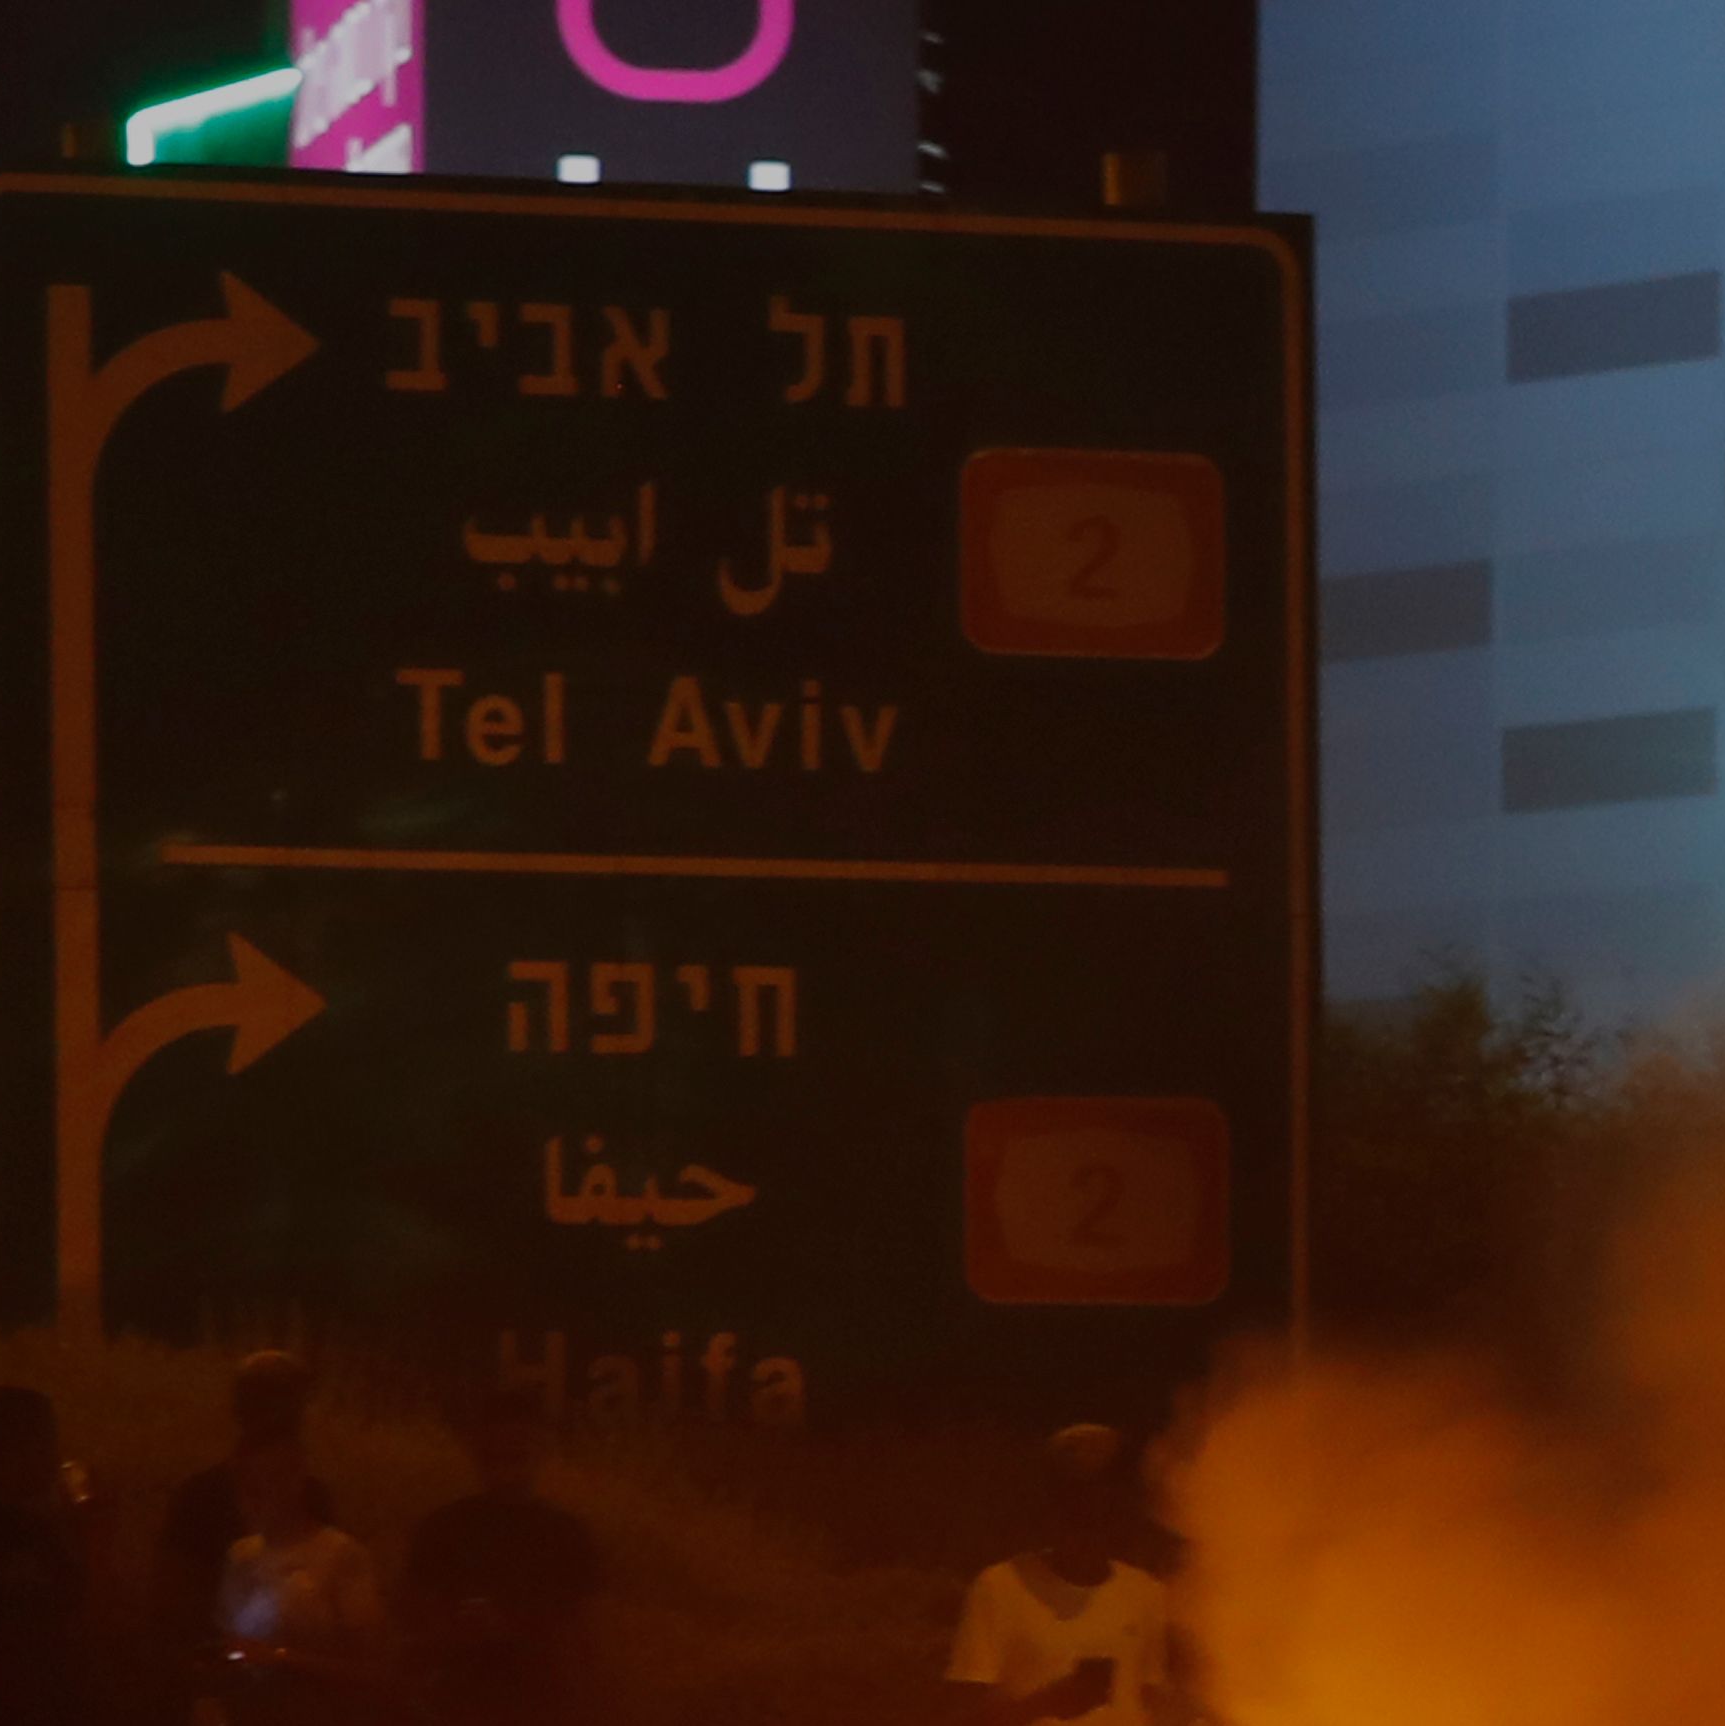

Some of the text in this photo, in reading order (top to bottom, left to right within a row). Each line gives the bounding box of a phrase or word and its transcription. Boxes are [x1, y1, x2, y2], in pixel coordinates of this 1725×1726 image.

[383, 294, 906, 407] תל אביב
[717, 483, 833, 615] تل
[1066, 516, 1119, 600] 2
[395, 667, 899, 773] Tel Aviv
[505, 960, 799, 1058] חיפה
[543, 1134, 758, 1252] حيفا
[1070, 1165, 1124, 1246] 2
[496, 1330, 807, 1424] Haifa
